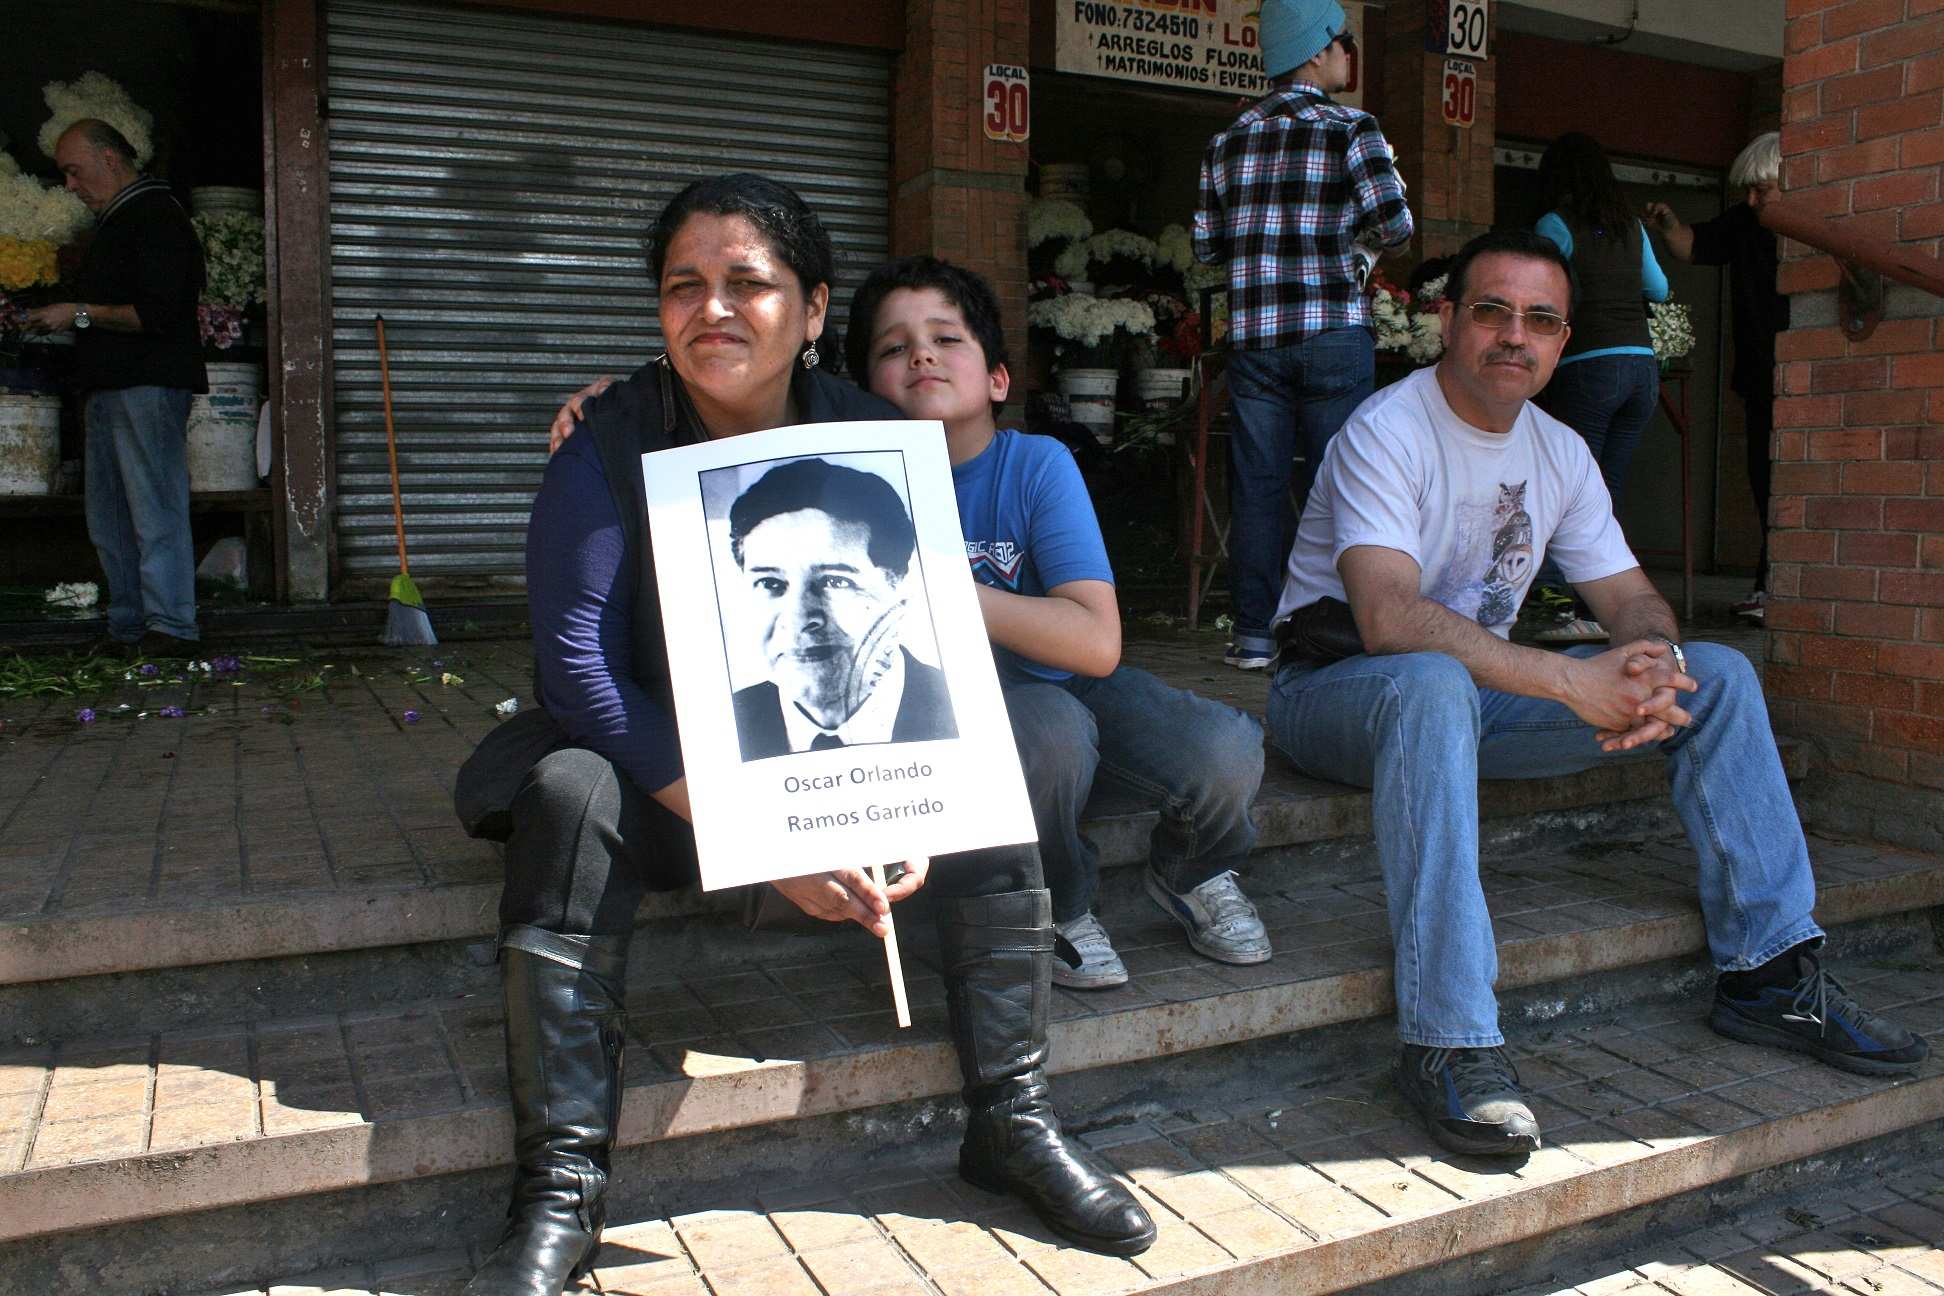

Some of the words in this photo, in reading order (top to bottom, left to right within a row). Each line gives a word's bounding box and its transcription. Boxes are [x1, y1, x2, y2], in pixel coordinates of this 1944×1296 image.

[1451, 4, 1485, 52] 30
[1097, 33, 1193, 62] ARREGLOS
[989, 65, 1027, 79] LOCAL
[1105, 55, 1209, 82] MATRIMONIOS
[1447, 60, 1475, 74] LOCAL
[987, 80, 1028, 134] 30
[1444, 74, 1474, 122] 30
[784, 772, 843, 793] Oscar
[850, 761, 933, 784] Orlando
[787, 810, 860, 832] Ramos
[866, 798, 944, 822] Garrido
